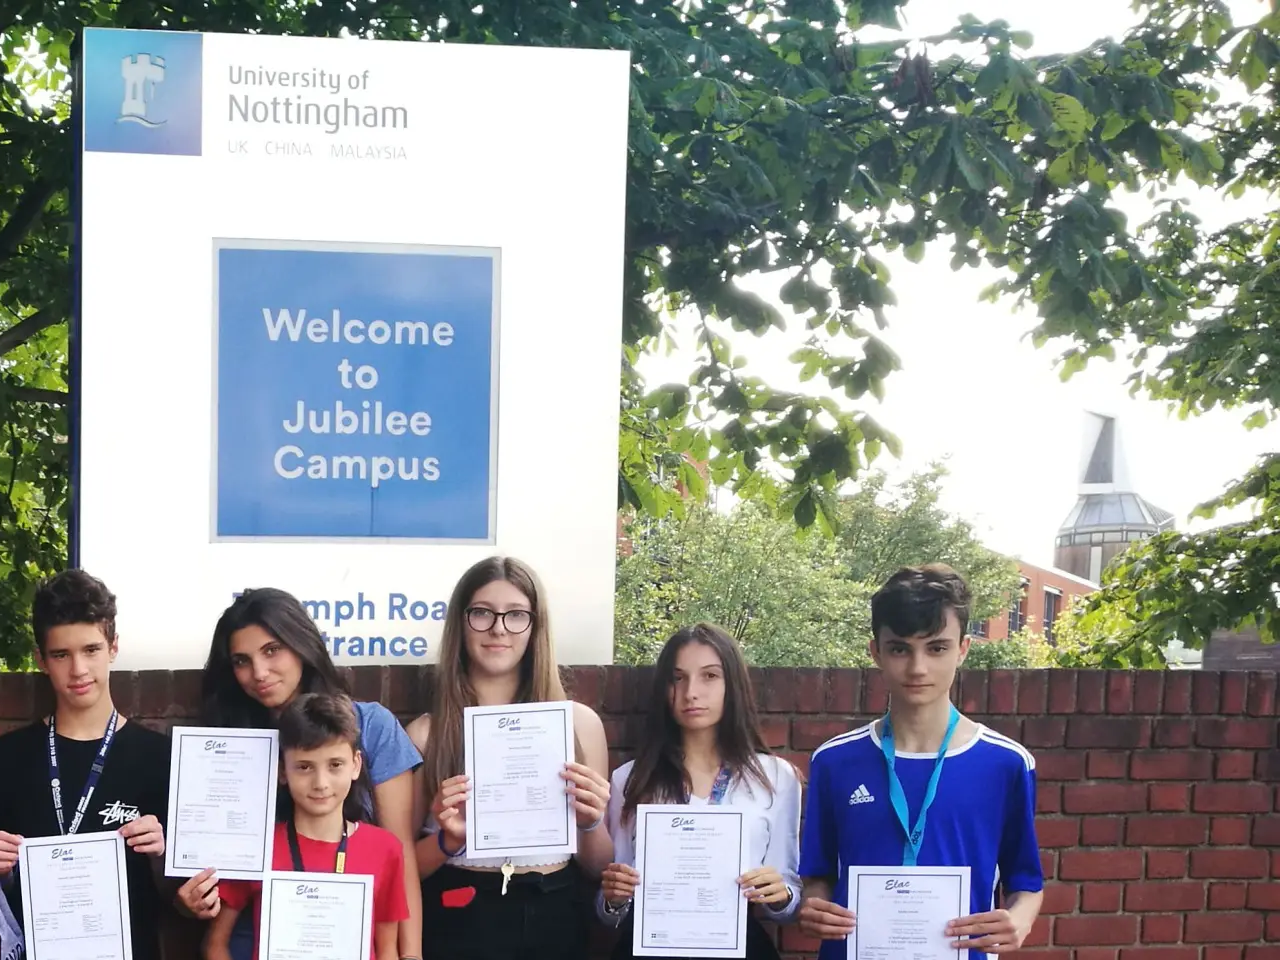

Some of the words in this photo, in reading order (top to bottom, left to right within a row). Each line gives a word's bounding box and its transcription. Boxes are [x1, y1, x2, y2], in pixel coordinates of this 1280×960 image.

[228, 65, 341, 94] University
[348, 70, 370, 90] of
[228, 94, 408, 134] Nottingham
[228, 140, 248, 154] UK
[265, 141, 313, 156] CHINA
[330, 144, 408, 160] MALAYSIA
[262, 307, 455, 346] Welcome
[337, 358, 379, 390] to
[282, 400, 432, 436] Jubilee
[274, 445, 441, 488] Campus
[388, 592, 448, 621] Roa
[320, 631, 429, 657] trance
[848, 795, 875, 805] adidas
